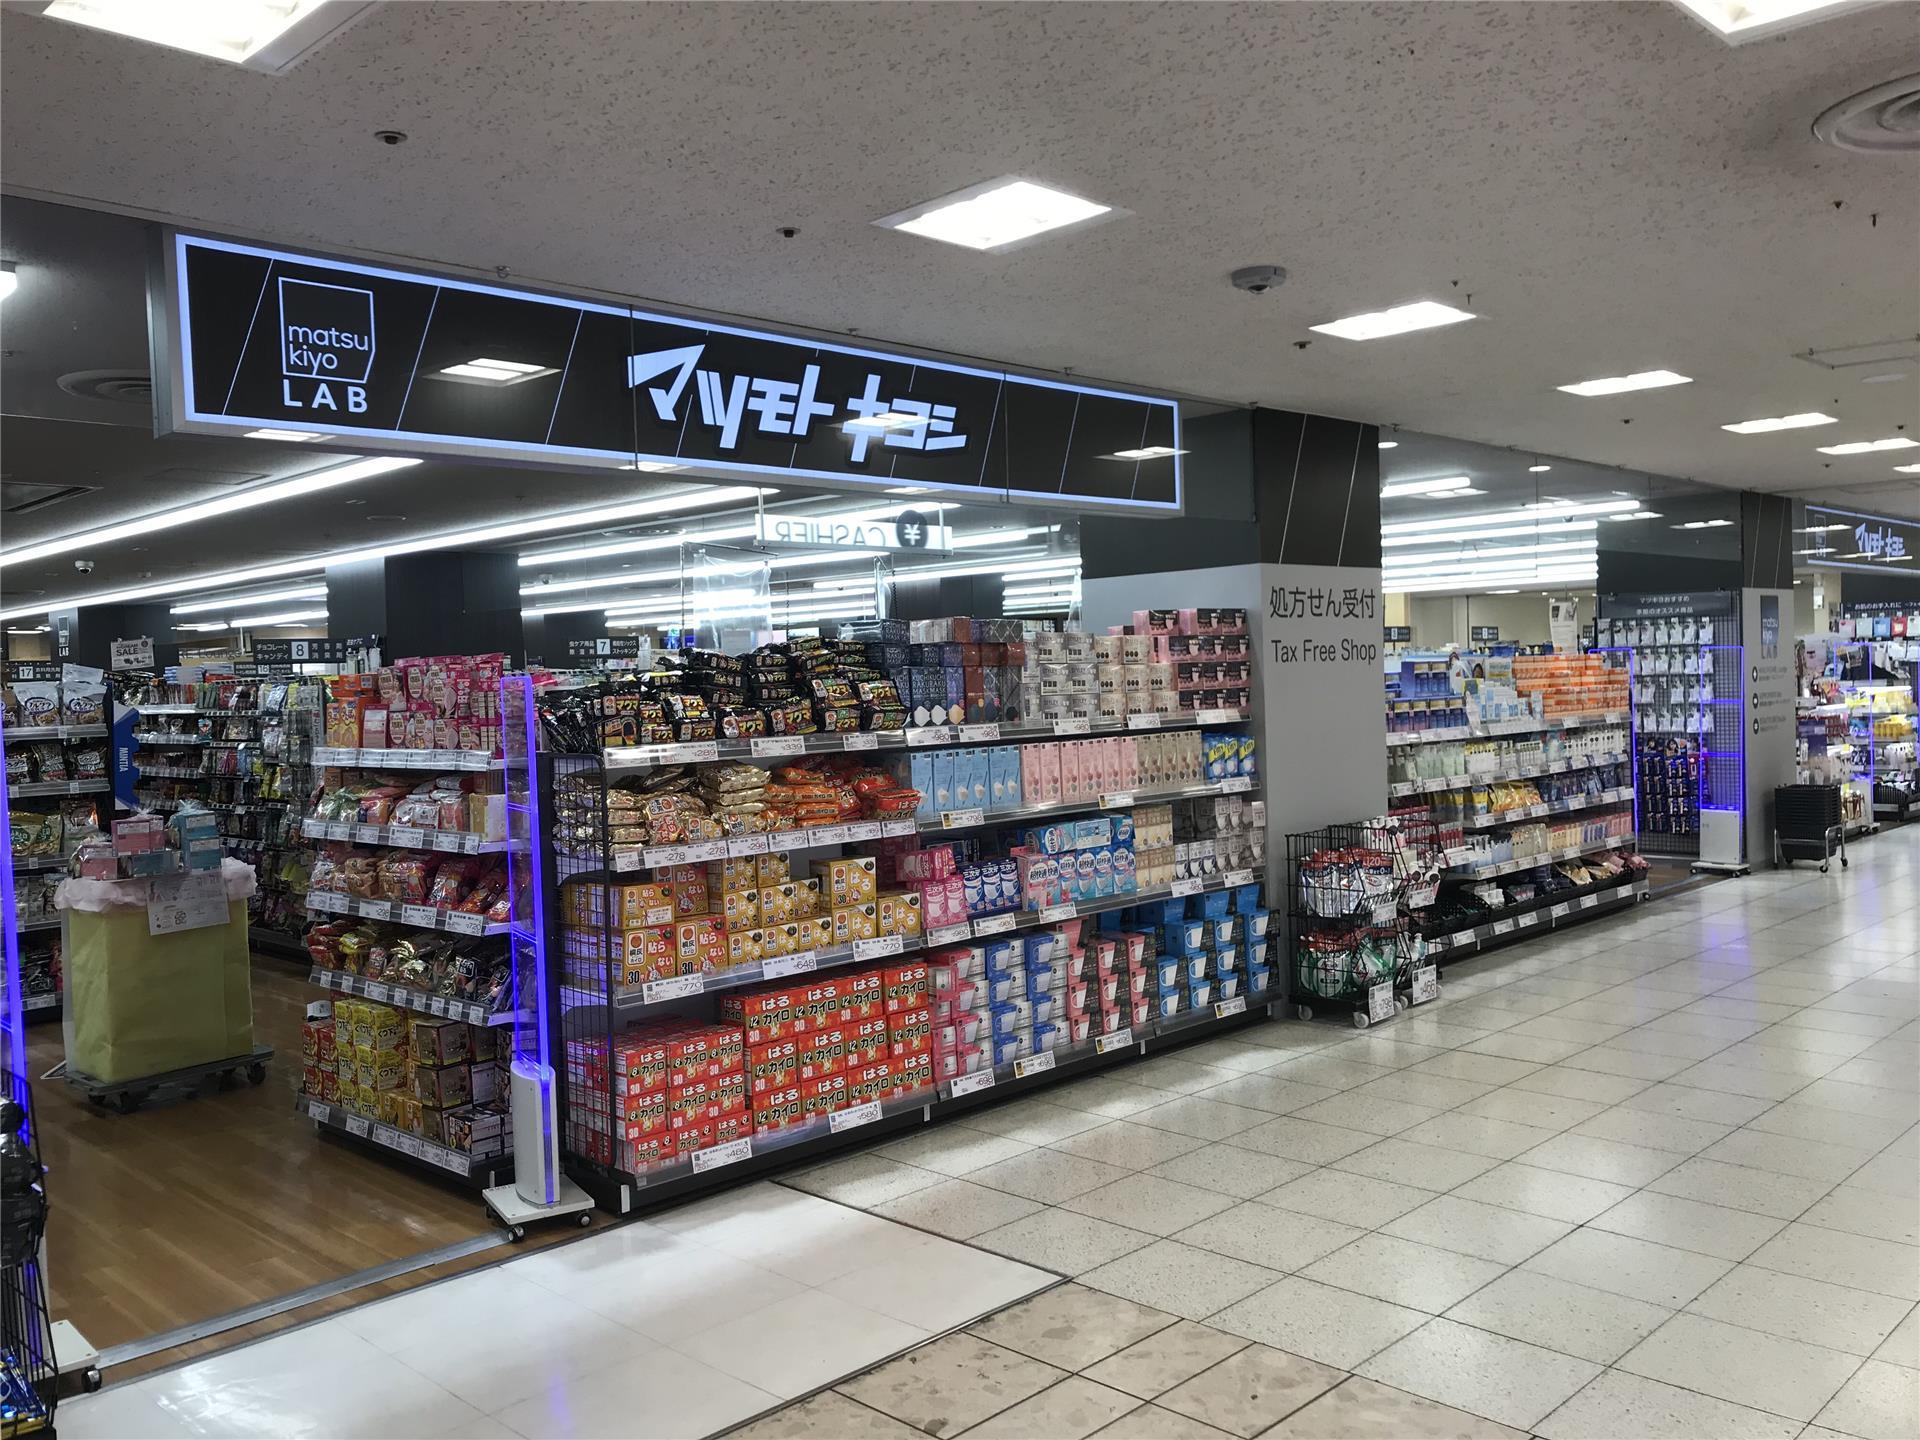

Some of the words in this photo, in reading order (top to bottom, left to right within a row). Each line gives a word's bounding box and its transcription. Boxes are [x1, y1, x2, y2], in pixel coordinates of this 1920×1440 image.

[288, 325, 368, 350] matsu
[289, 343, 338, 376] kiyo
[283, 379, 368, 413] LAB
[627, 344, 967, 462] マツモトキヨシ
[1270, 586, 1375, 618] 処方せん受付
[116, 648, 139, 657] SALE
[296, 644, 304, 656] 8
[600, 641, 606, 652] 7
[1271, 640, 1297, 662] Tax
[1304, 639, 1336, 662] Free
[1341, 638, 1376, 664] Shop
[20, 668, 32, 677] 17
[826, 685, 848, 693] マグマ
[872, 688, 891, 696] マグマ
[616, 701, 638, 710] マグマ
[684, 699, 703, 707] マグマ
[787, 711, 810, 723] マグマ
[739, 719, 765, 732] マグマ
[694, 728, 712, 736] マグマ
[119, 747, 129, 772] MINTIA
[1000, 862, 1016, 870] 三次元
[677, 872, 695, 882] 貼ら
[963, 869, 980, 877] 三次元
[688, 885, 705, 894] ない
[699, 933, 717, 944] 貼ら
[648, 942, 665, 954] 貼ら
[710, 947, 725, 956] ない
[658, 957, 673, 966] ない
[682, 962, 693, 974] 30
[628, 971, 639, 984] 30
[900, 969, 925, 981] はる
[854, 977, 880, 990] はる
[901, 981, 925, 995] カイロ
[808, 987, 836, 1001] はる
[855, 989, 880, 1004] カイロ
[762, 996, 790, 1011] はる
[809, 1000, 836, 1015] カイロ
[888, 1000, 898, 1011] 30
[763, 1010, 789, 1025] カイロ
[841, 1010, 850, 1021] 30
[905, 1010, 929, 1024] はる
[795, 1020, 805, 1031] 30
[860, 1021, 885, 1035] はる
[906, 1023, 929, 1038] カイロ
[720, 1033, 741, 1044] はる
[750, 1030, 760, 1042] 30
[815, 1032, 842, 1046] はる
[861, 1034, 885, 1048] カイロ
[683, 1042, 706, 1054] はる
[721, 1044, 741, 1055] カイロ
[768, 1043, 794, 1059] はる
[816, 1045, 842, 1061] カイロ
[894, 1043, 903, 1054] 30
[641, 1051, 664, 1063] はる
[684, 1053, 706, 1065] カイロ
[848, 1053, 858, 1065] 30
[905, 1054, 929, 1068] はる
[642, 1061, 664, 1074] カイロ
[769, 1057, 794, 1073] カイロ
[803, 1065, 813, 1077] 30
[863, 1065, 889, 1080] はる
[906, 1067, 929, 1082] カイロ
[720, 1075, 742, 1086] はる
[755, 1079, 765, 1090] 30
[818, 1077, 844, 1091] はる
[864, 1078, 888, 1092] カイロ
[683, 1084, 705, 1096] はる
[720, 1085, 742, 1097] カイロ
[639, 1094, 664, 1106] はる
[684, 1095, 705, 1107] カイロ
[771, 1089, 798, 1105] はる
[819, 1090, 844, 1106] カイロ
[640, 1105, 664, 1117] カイロ
[771, 1103, 798, 1119] カイロ
[719, 1119, 737, 1129] はる
[679, 1129, 698, 1139] はる
[719, 1128, 737, 1138] カイロ
[638, 1140, 658, 1150] はる
[680, 1138, 698, 1149] カイロ
[639, 1148, 658, 1159] カイロ
